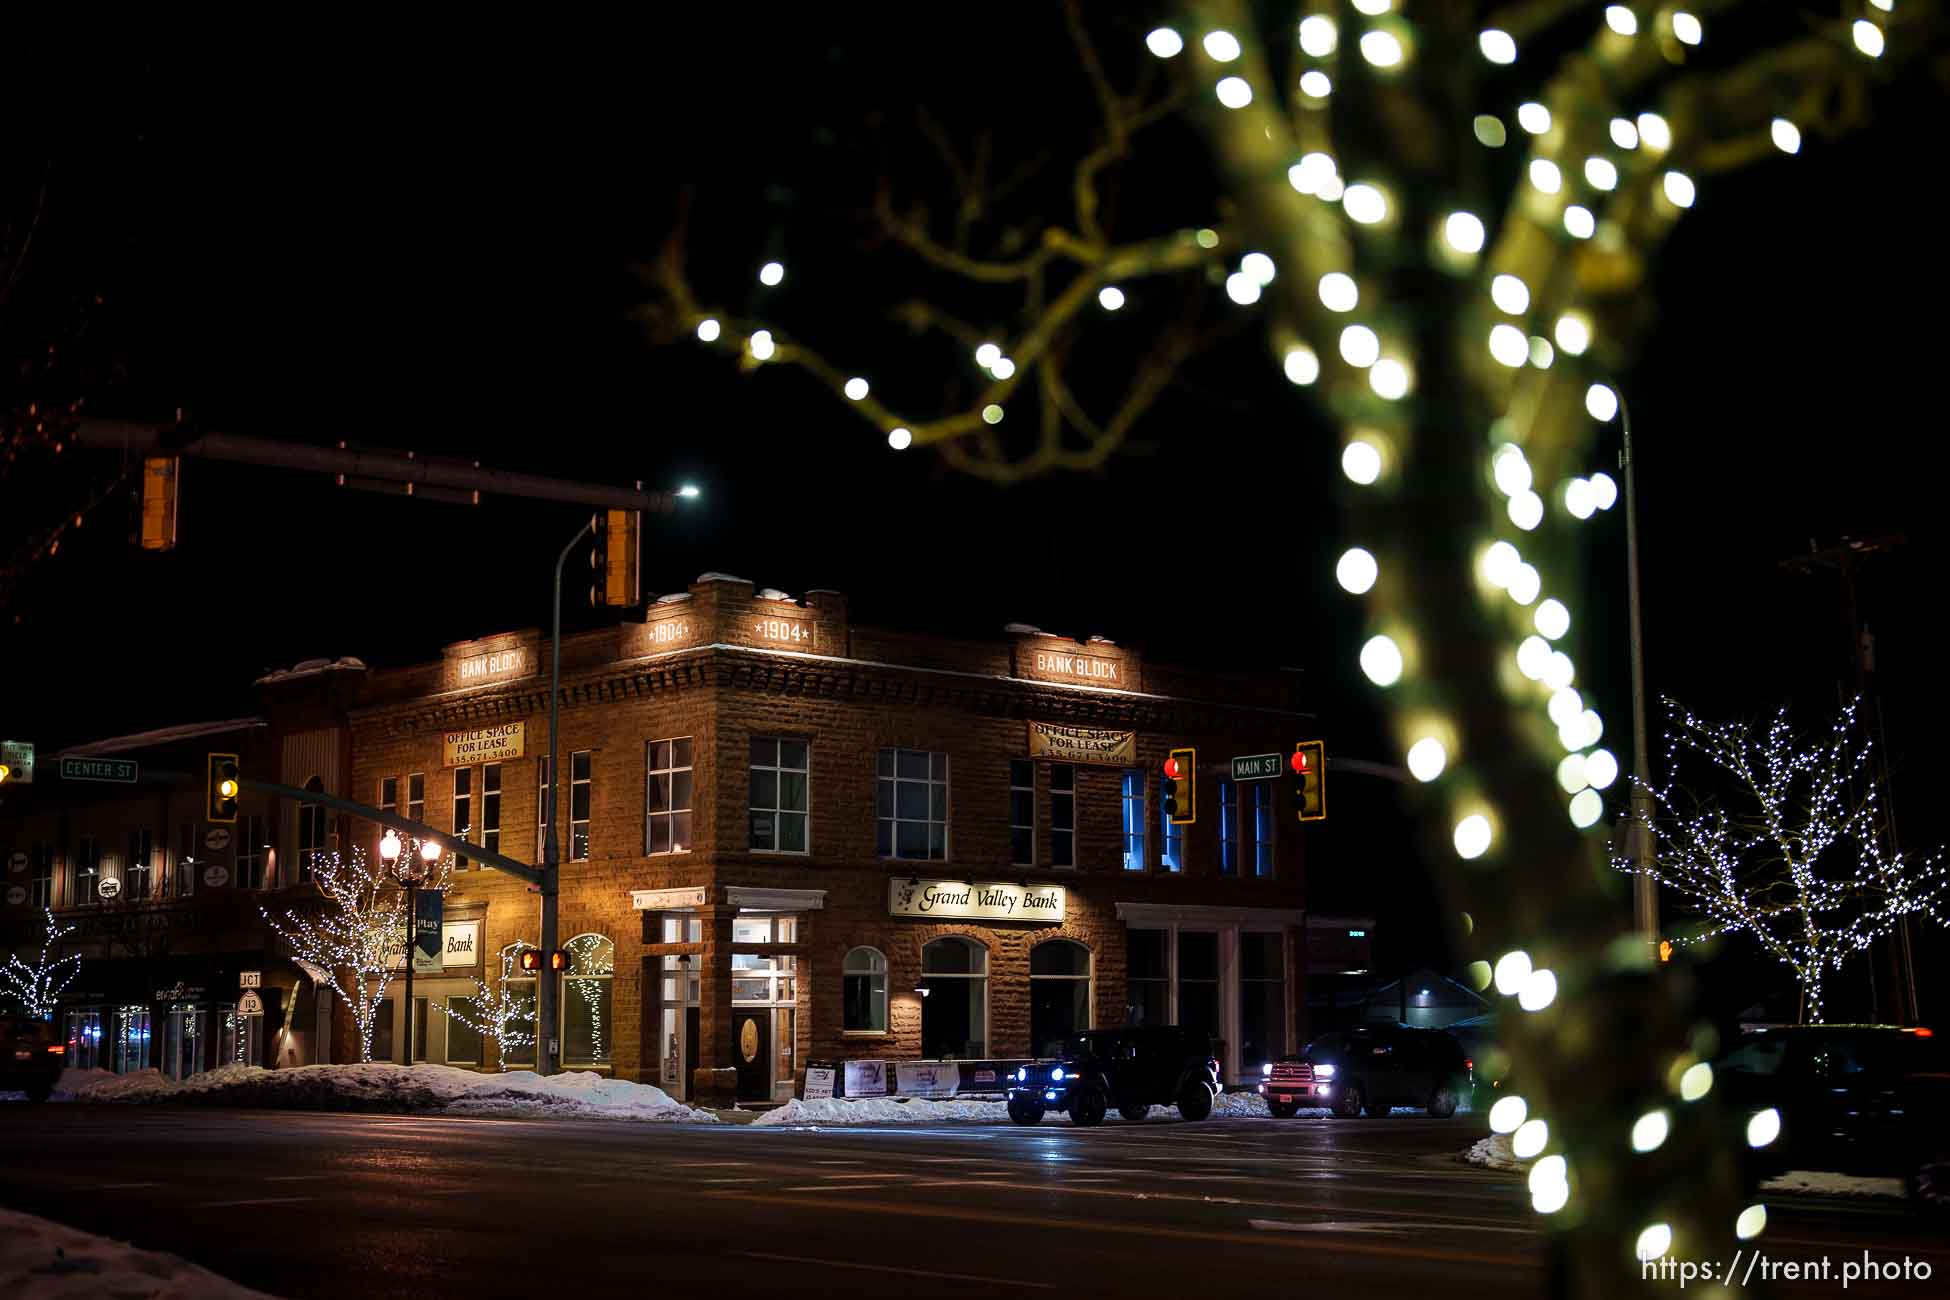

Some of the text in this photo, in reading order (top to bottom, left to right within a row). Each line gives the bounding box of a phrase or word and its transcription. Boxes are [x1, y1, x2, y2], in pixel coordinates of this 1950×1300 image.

[654, 622, 683, 643] 1904
[762, 621, 801, 642] 1904
[462, 651, 522, 680] BANK BLOCK
[1037, 654, 1117, 679] BANK BLOCK
[447, 724, 520, 744] OFFICE SPACE
[1036, 724, 1128, 743] OFFICE SPACE
[457, 737, 508, 754] FOR LEASE
[1050, 737, 1114, 752] FOR LEASE
[66, 761, 131, 777] CENTER ST
[1237, 759, 1277, 776] MAIN ST
[918, 886, 1058, 914] Grand Valley Bank
[447, 933, 473, 953] Bank
[241, 974, 258, 986] JCT
[245, 999, 256, 1009] 113
